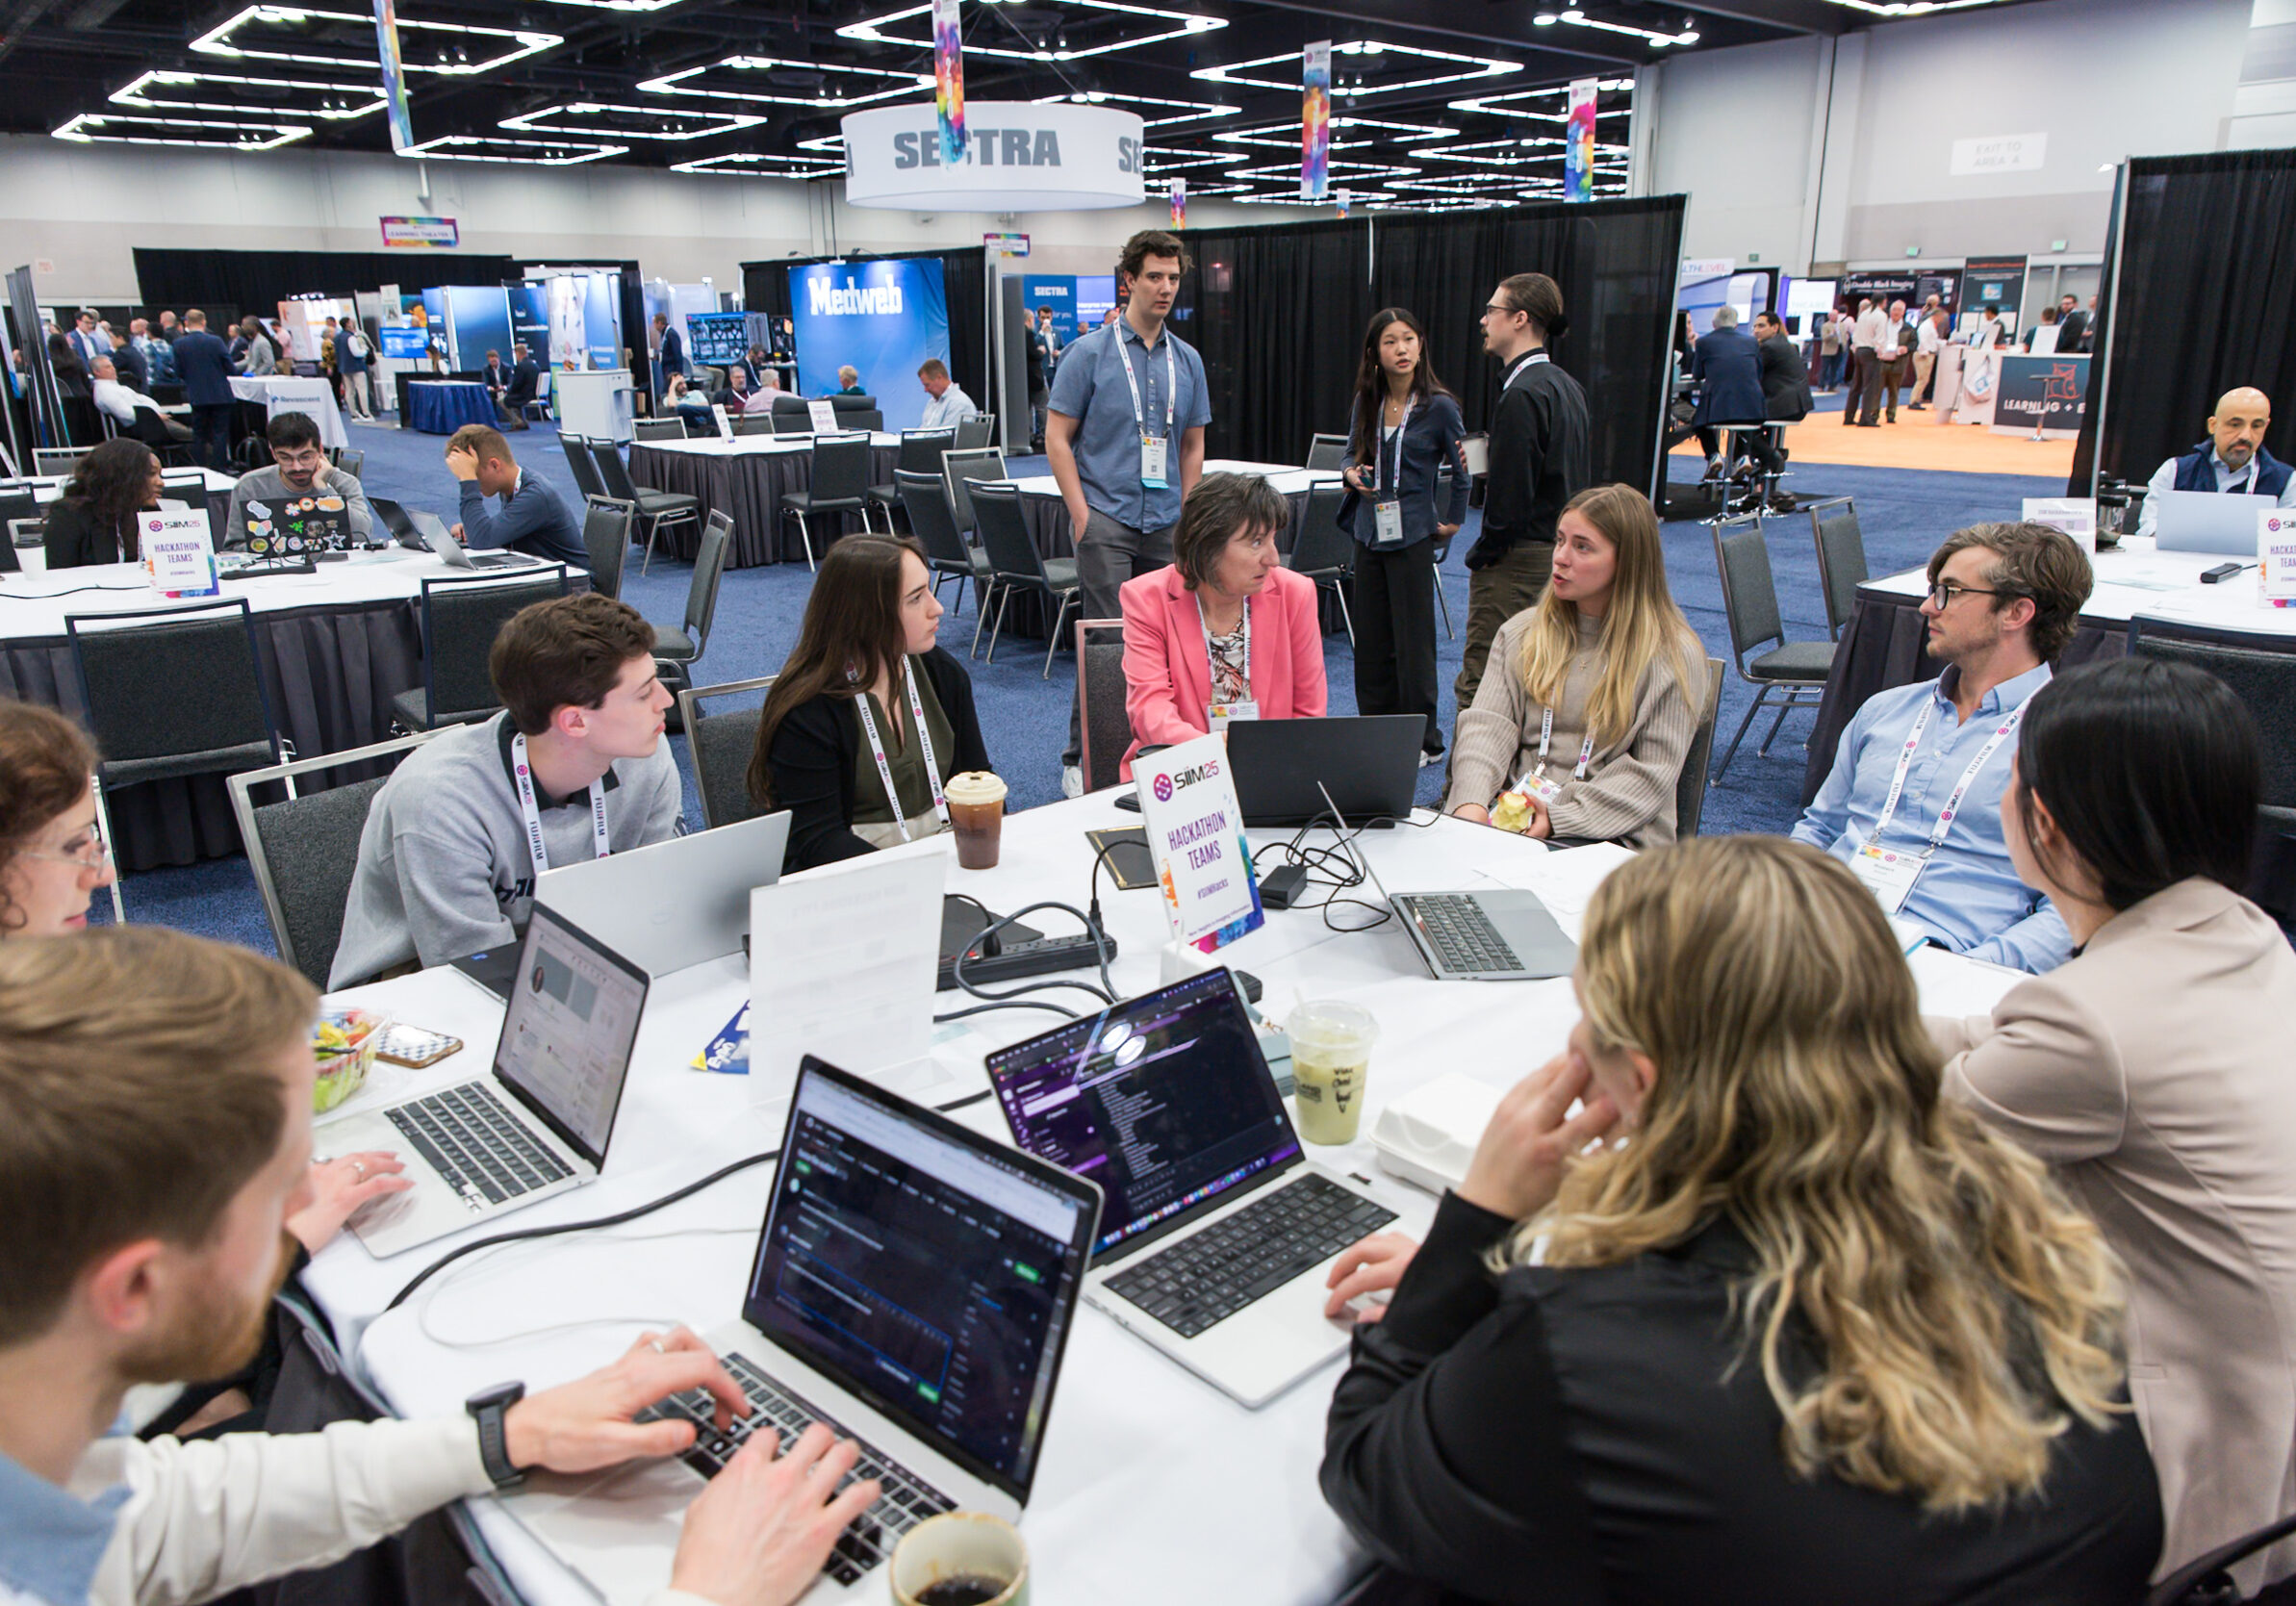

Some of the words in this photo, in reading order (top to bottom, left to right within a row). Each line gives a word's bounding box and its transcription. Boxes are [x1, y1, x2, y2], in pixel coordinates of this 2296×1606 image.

[894, 129, 1061, 169] SETRA
[2005, 140, 2022, 152] TO
[808, 273, 903, 316] Medweb
[1033, 286, 1068, 296] SECTRA
[154, 542, 200, 552] HACKATHON
[167, 553, 192, 563] TEAMS
[595, 797, 606, 836] FUJIFILM
[1167, 810, 1227, 852] HACKATHON
[529, 821, 545, 860] FUJIFILM
[1187, 840, 1222, 871] TEAMS
